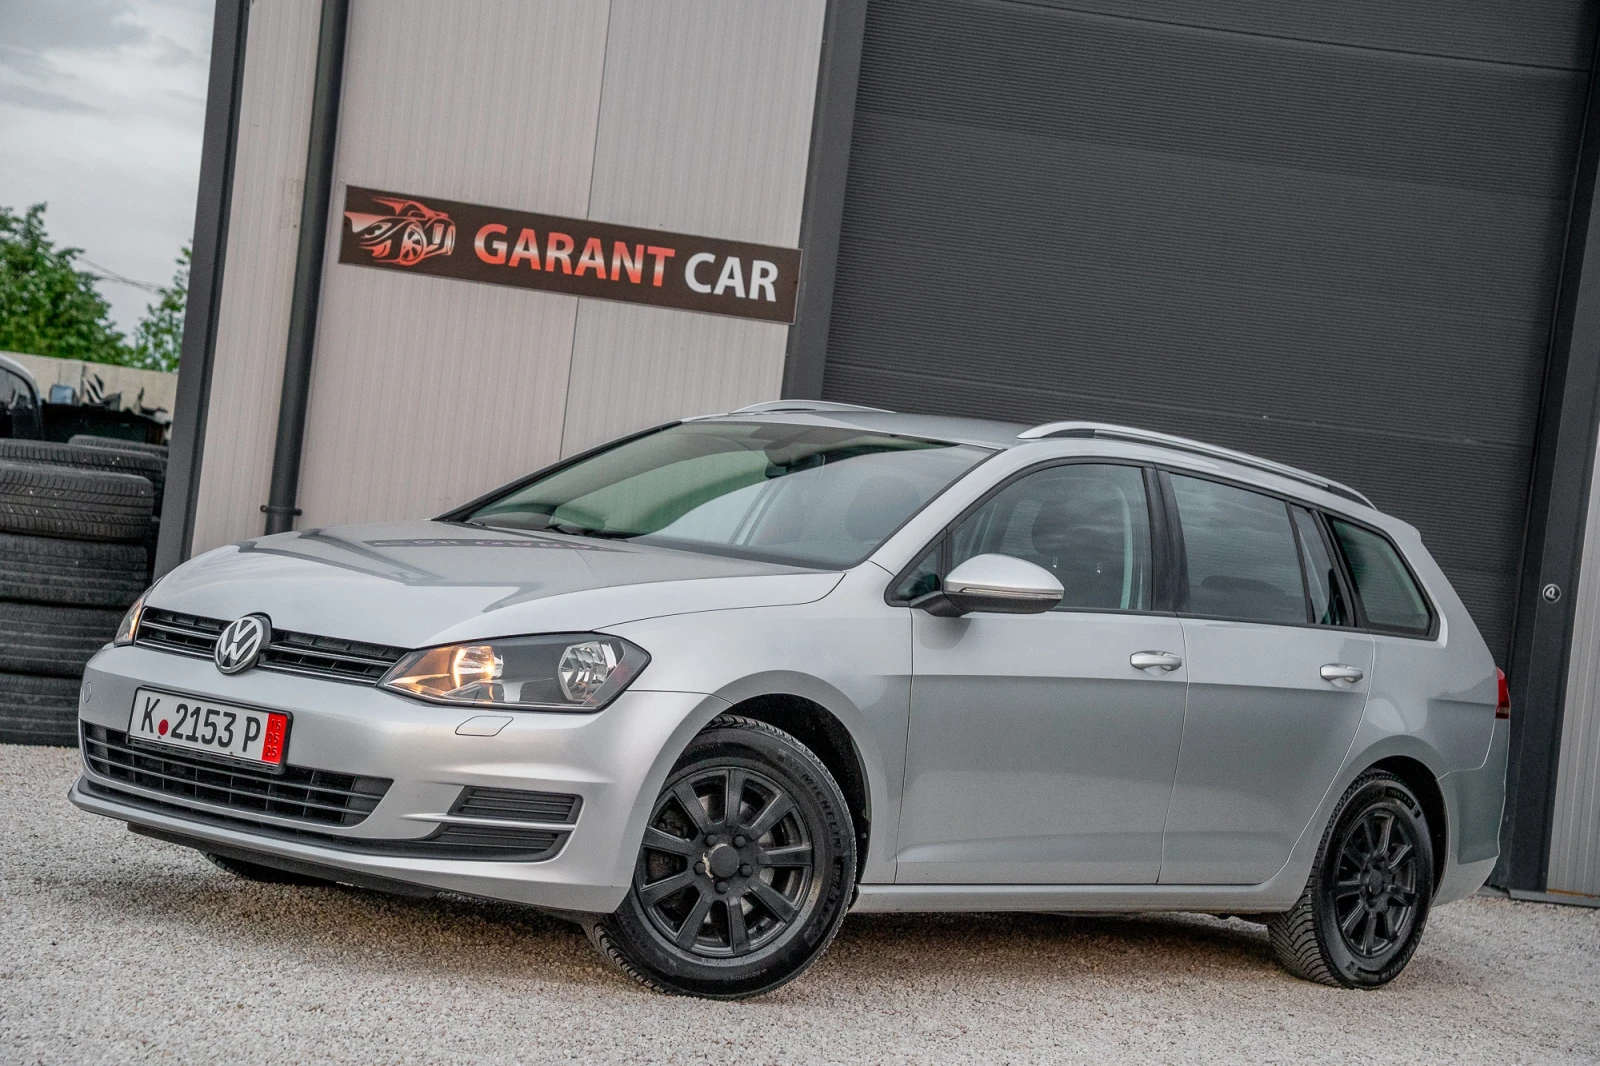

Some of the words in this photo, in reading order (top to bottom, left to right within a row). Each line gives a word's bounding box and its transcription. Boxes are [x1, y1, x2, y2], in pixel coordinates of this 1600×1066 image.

[473, 223, 676, 288] GARANT
[684, 252, 779, 302] CAR
[140, 696, 161, 734] K
[170, 703, 237, 748] 2153
[242, 716, 261, 752] P
[268, 731, 280, 744] 05
[271, 718, 282, 731] 16
[265, 744, 278, 757] 25
[801, 772, 842, 849] MICHELIN
